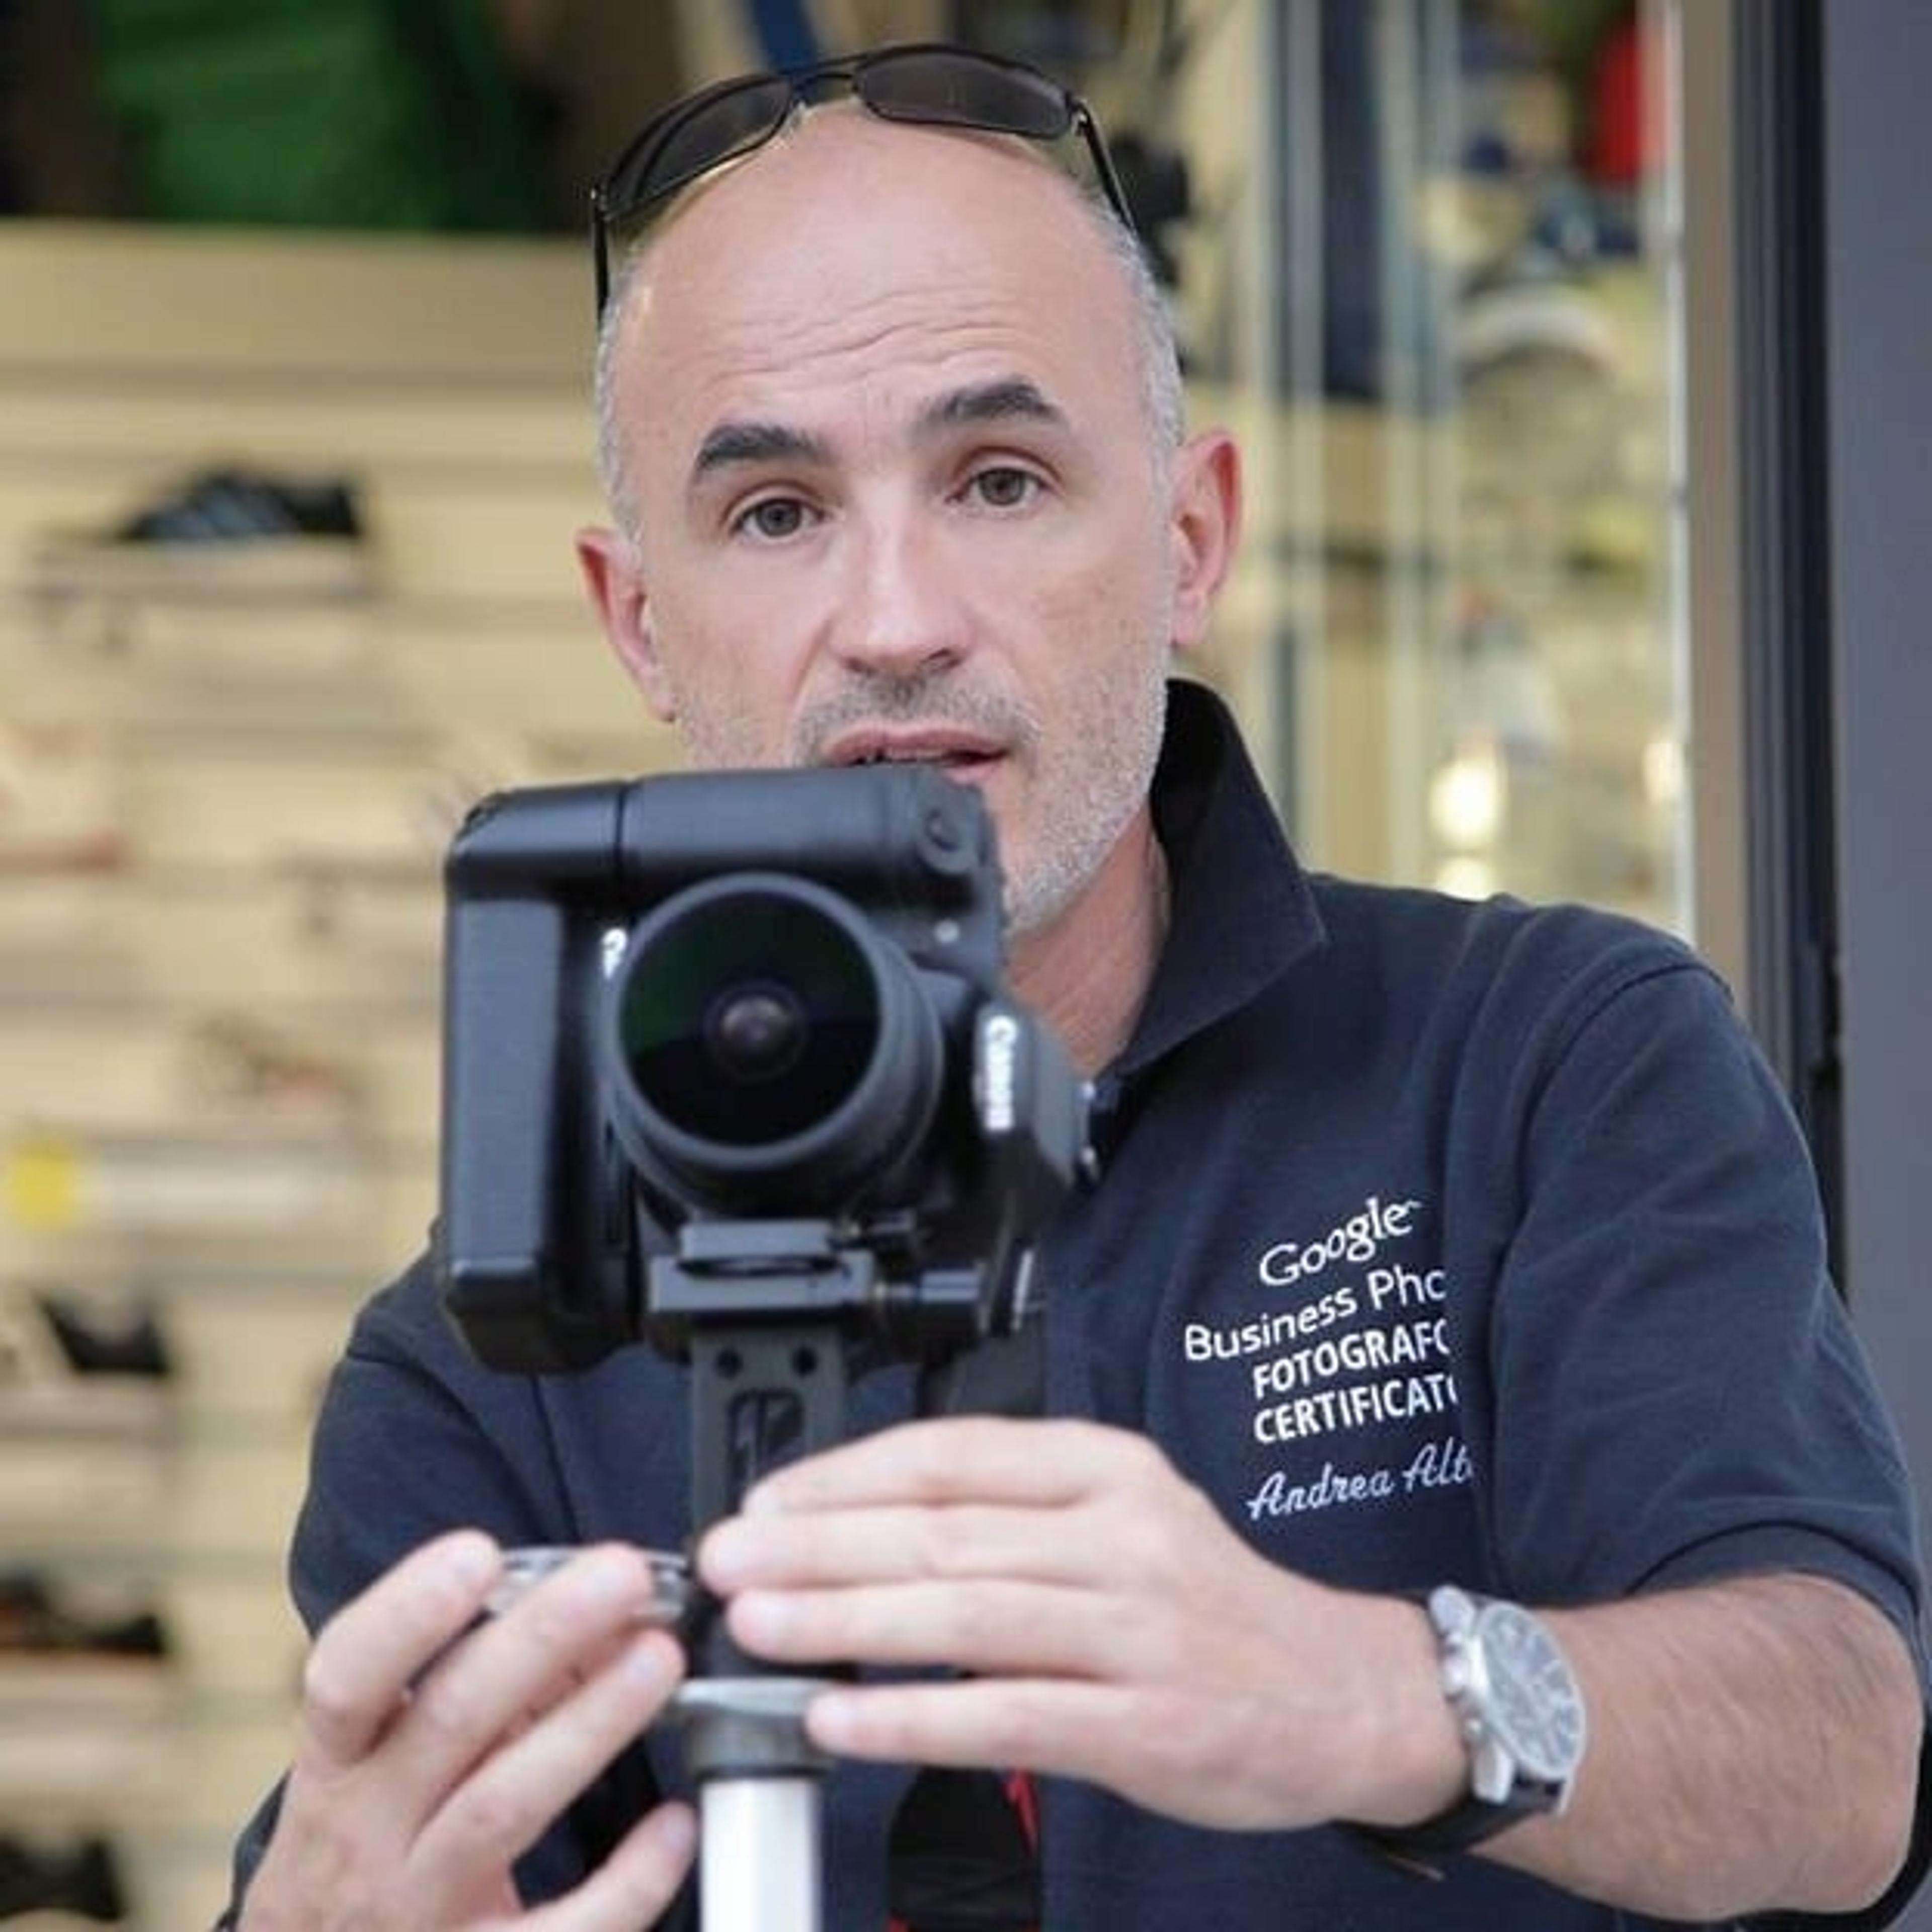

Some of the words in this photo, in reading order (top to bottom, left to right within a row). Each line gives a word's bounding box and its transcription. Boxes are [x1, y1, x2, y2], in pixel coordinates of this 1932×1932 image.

[985, 1015, 1016, 1131] Canon
[1259, 1195, 1421, 1286] Google
[1184, 1286, 1358, 1361] Business
[1246, 1462, 1394, 1521] Andrea
